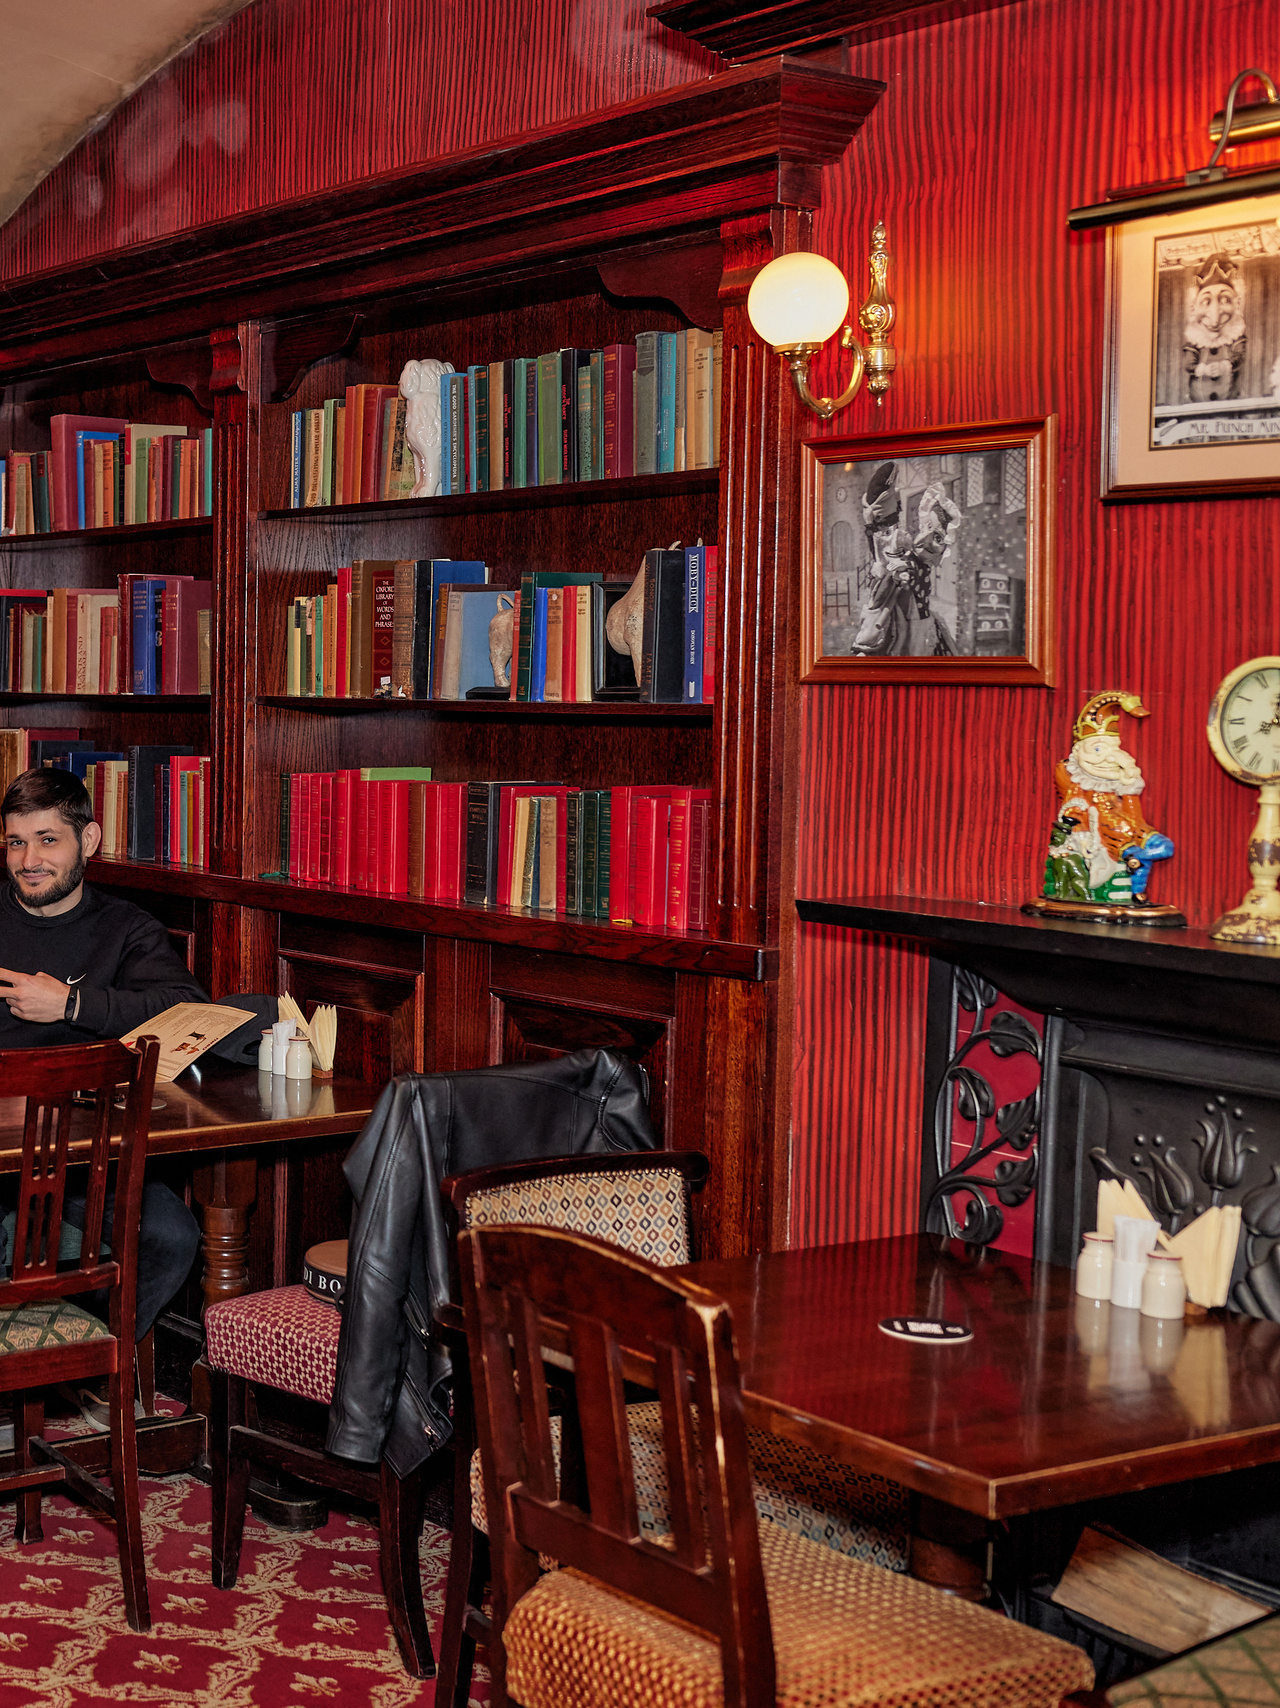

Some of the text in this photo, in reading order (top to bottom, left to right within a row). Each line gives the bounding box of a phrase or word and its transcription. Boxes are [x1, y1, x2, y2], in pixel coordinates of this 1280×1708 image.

[1214, 421, 1254, 434] PUNCH
[707, 572, 718, 596] FRED
[706, 599, 716, 646] TRUEMAN
